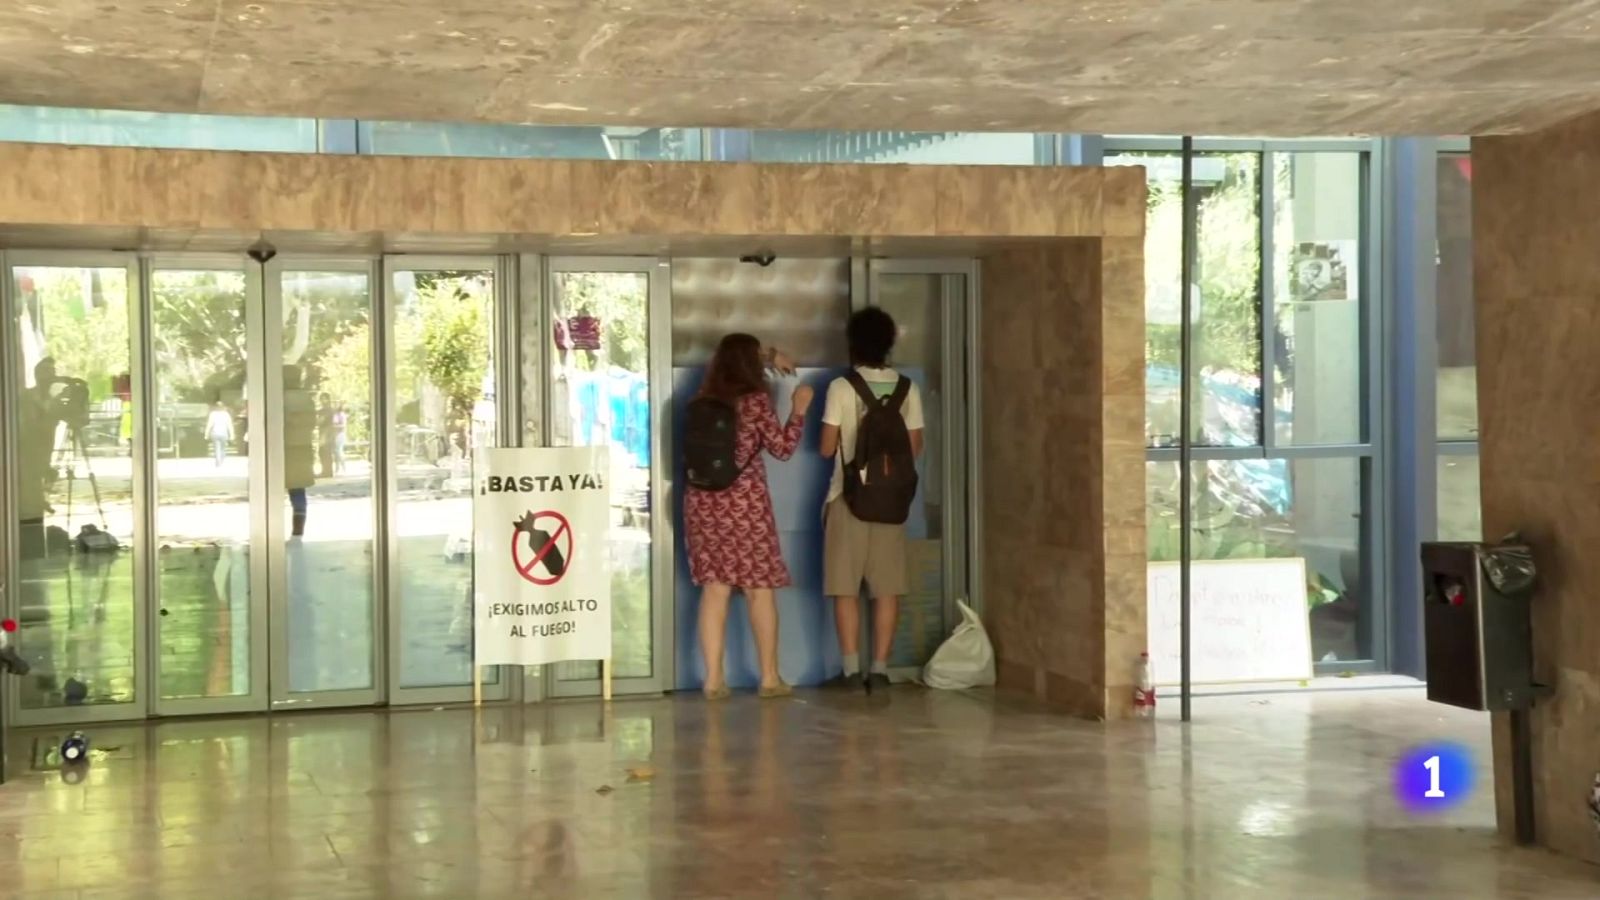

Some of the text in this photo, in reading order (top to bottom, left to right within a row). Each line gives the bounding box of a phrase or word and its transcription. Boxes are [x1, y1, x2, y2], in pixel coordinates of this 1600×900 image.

[480, 473, 604, 496] ¡BASTA YA!
[488, 598, 598, 619] ¡EXIGIMOS ALTO
[510, 621, 576, 638] AL FUEGO!
